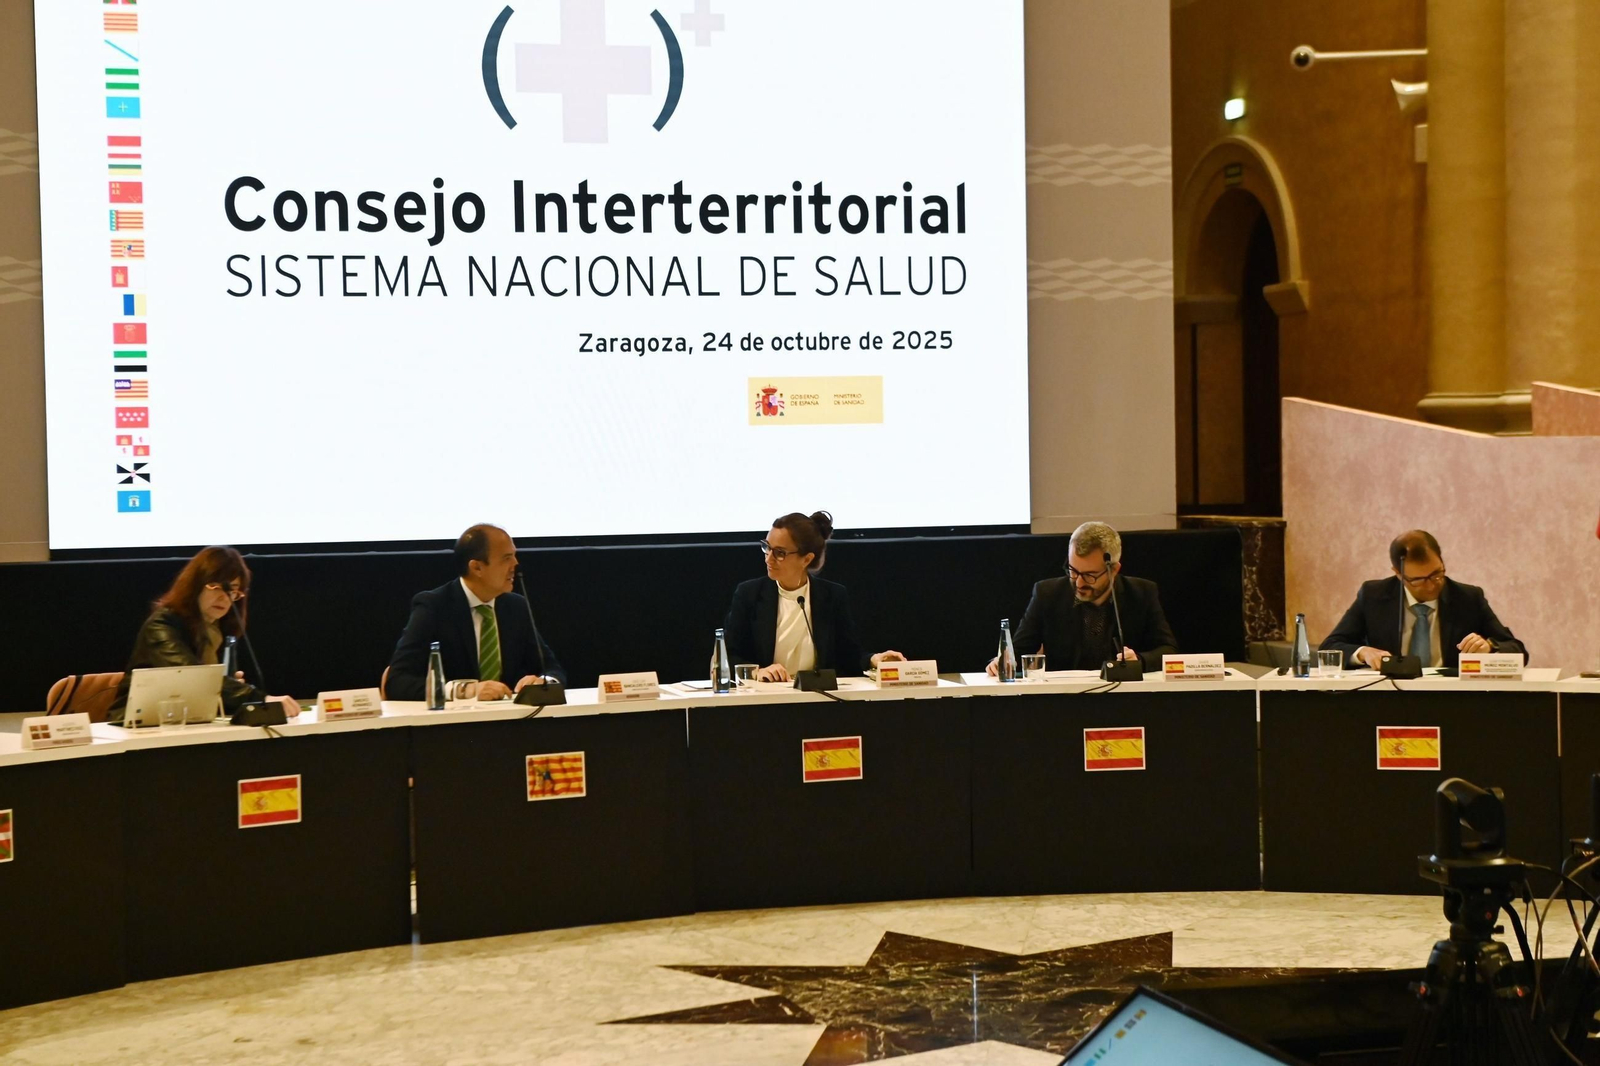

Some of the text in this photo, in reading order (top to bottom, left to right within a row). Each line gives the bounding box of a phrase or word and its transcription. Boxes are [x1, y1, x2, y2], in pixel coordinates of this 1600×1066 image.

[225, 176, 966, 246] Consejo Interterritorial
[226, 254, 967, 298] SISTEMA NACIONAL DE SALUD
[578, 330, 953, 358] Zaragoza, 24 de octubre de 2025
